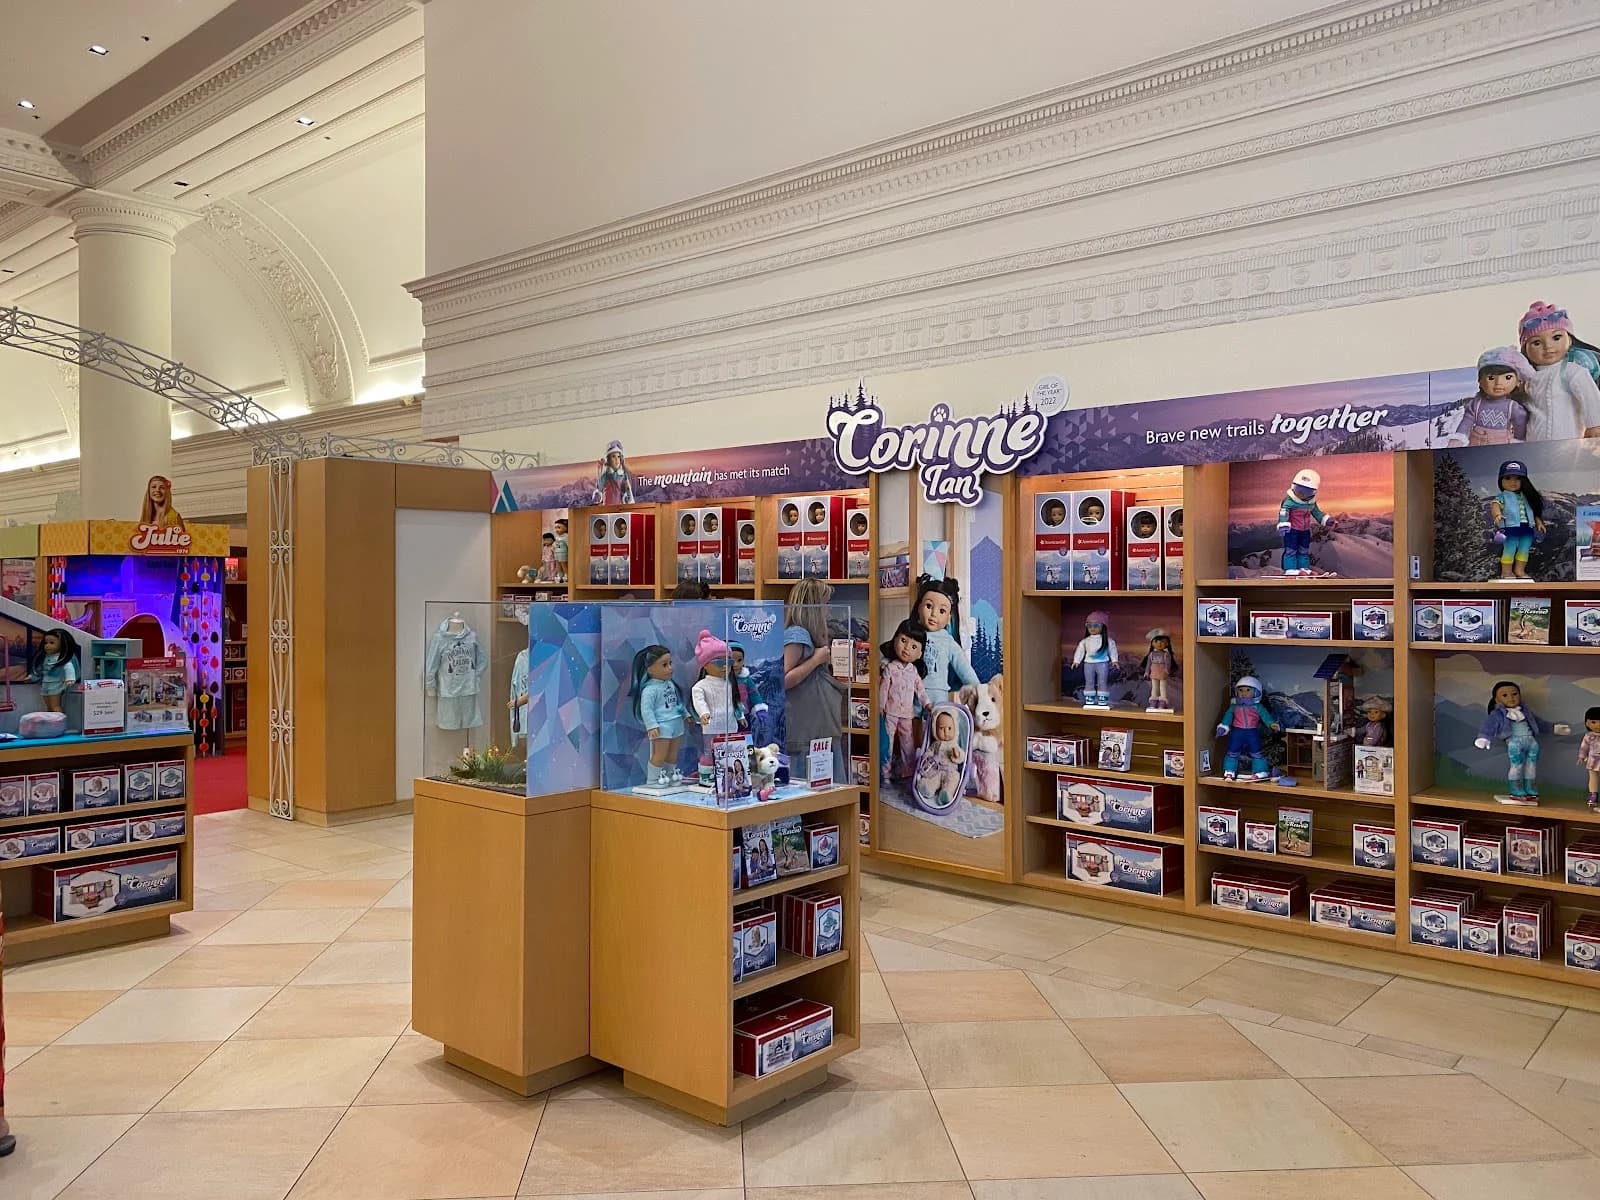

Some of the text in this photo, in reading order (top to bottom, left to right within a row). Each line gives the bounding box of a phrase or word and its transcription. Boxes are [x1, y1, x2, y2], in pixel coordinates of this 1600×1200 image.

[828, 408, 1040, 468] Corinne
[1146, 404, 1389, 444] Brave new trails together
[638, 463, 790, 488] The mountain has met its match
[925, 464, 976, 498] Tan
[131, 524, 191, 550] Julie
[812, 741, 829, 752] SALE
